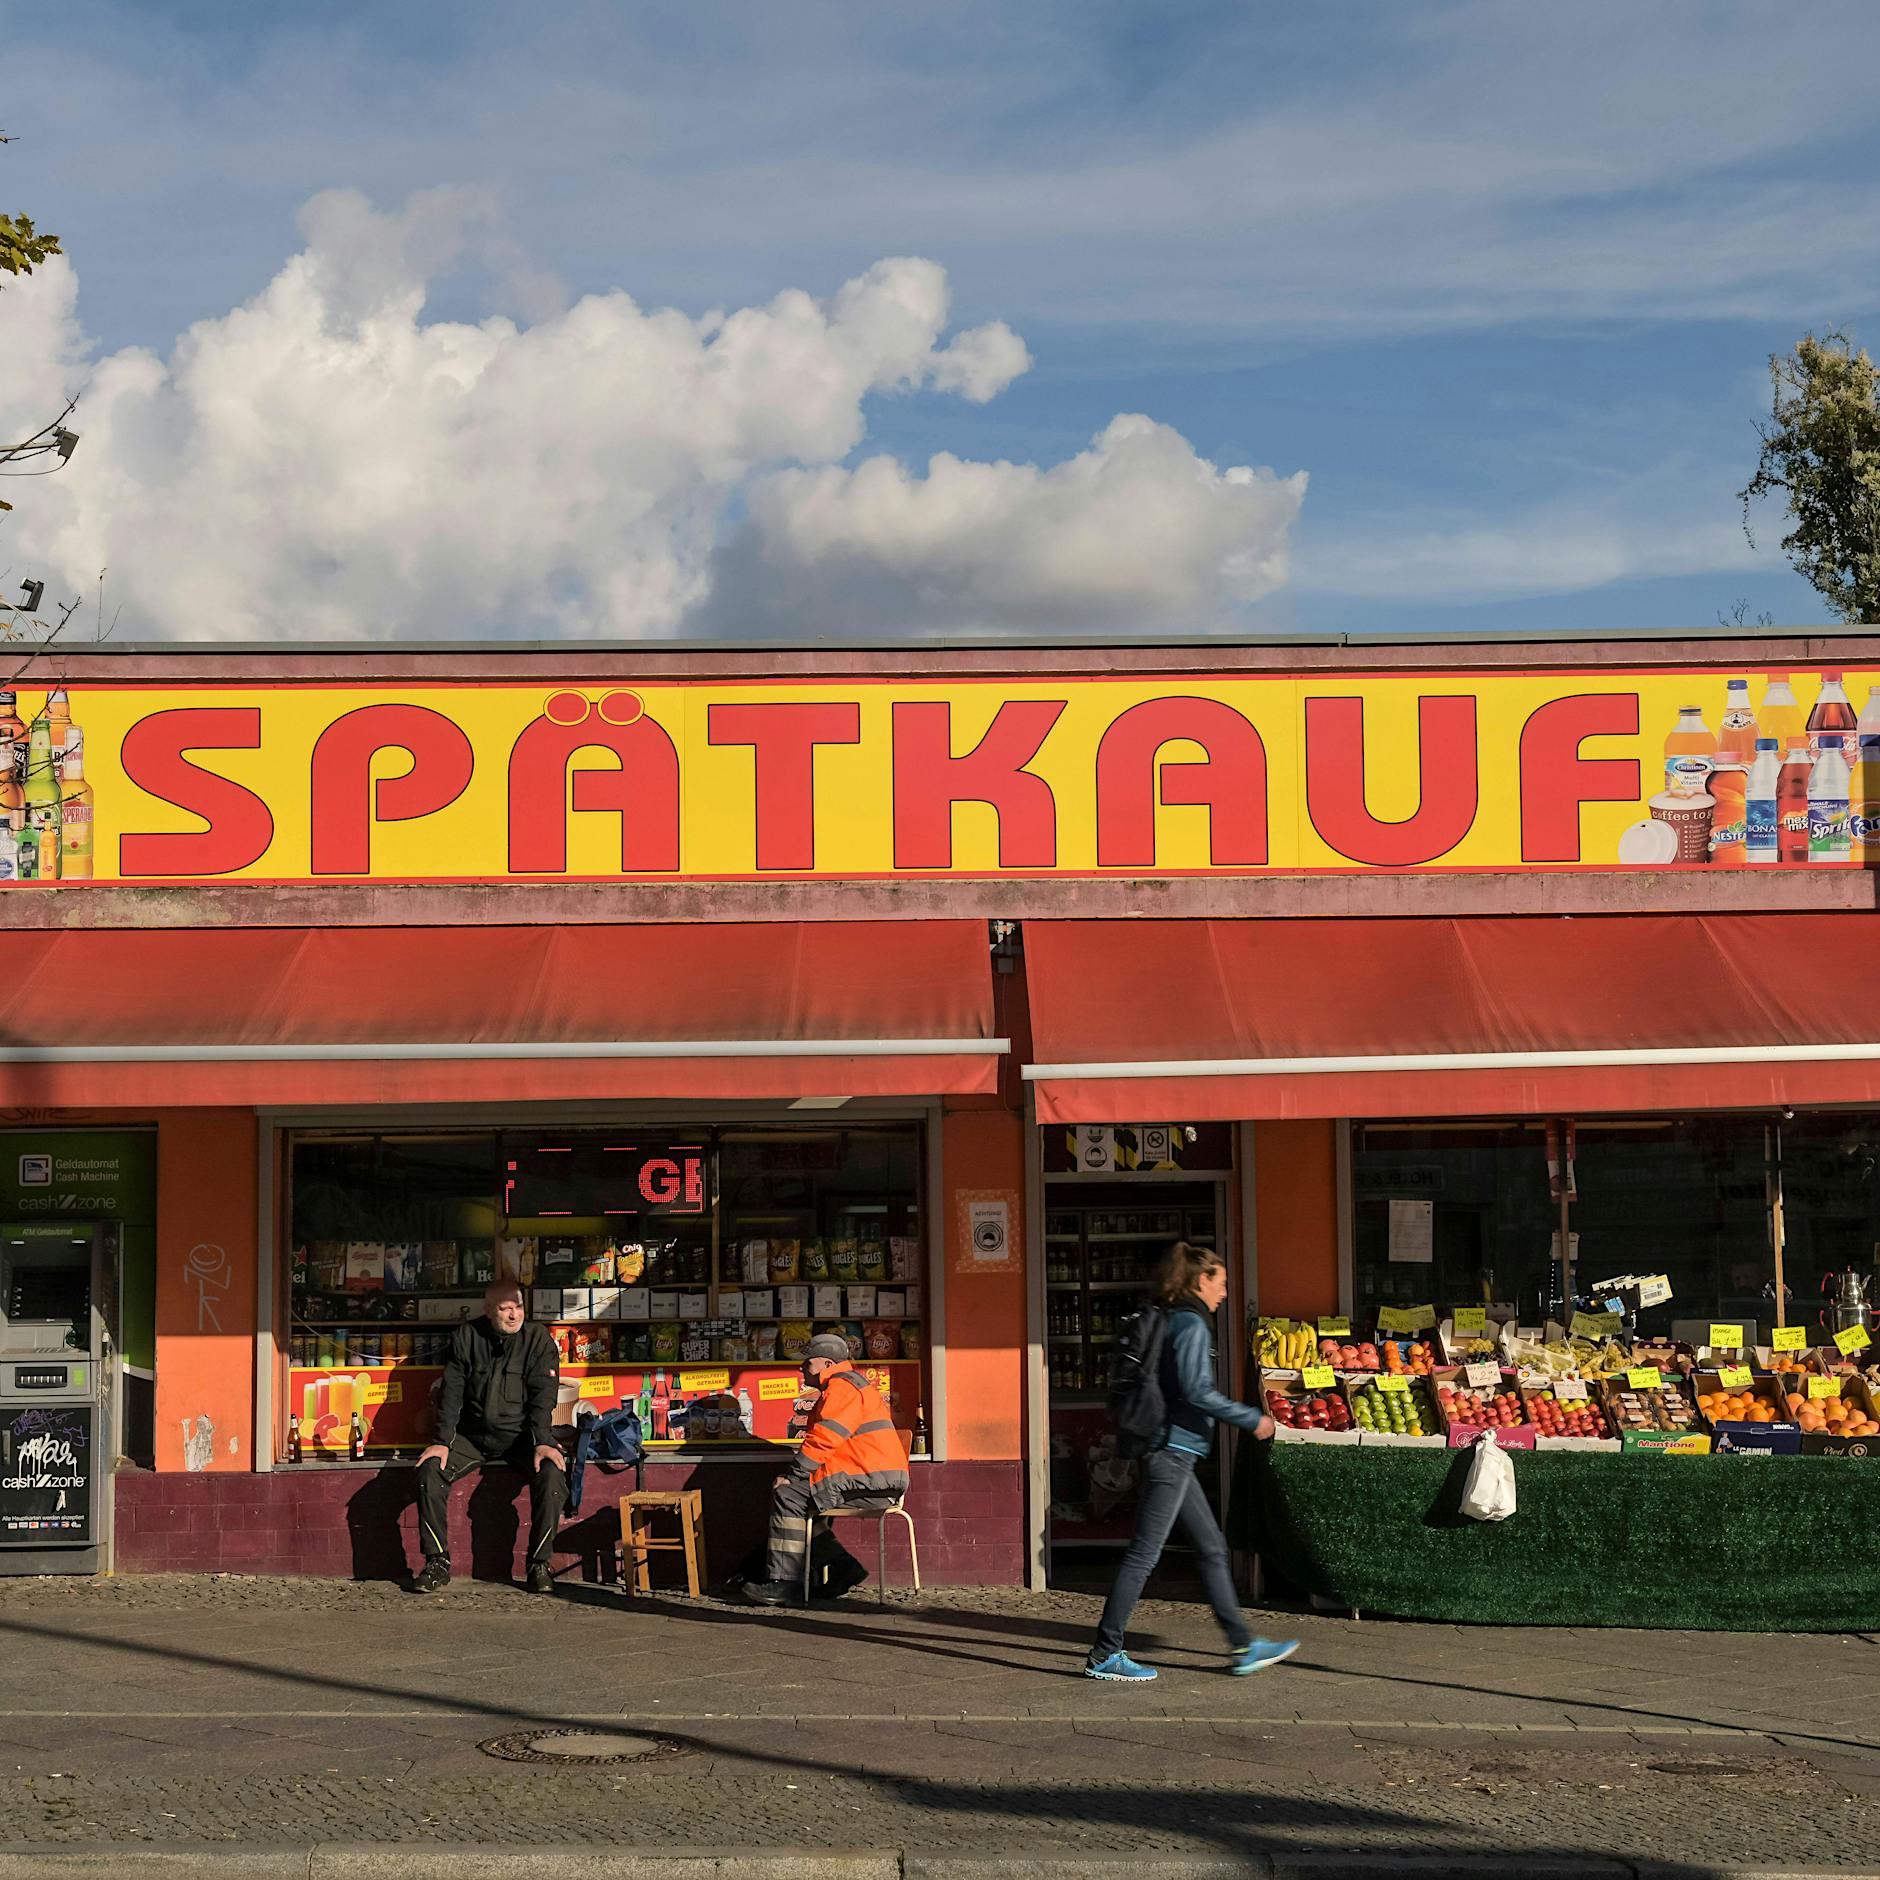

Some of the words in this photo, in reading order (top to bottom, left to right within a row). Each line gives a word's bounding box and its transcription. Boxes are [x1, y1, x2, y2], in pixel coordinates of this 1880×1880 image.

[120, 689, 1641, 876] SPÄTKAUF
[1784, 816, 1808, 826] mez
[55, 1159, 119, 1169] Geldautomat
[56, 1173, 78, 1181] Cash
[80, 1172, 119, 1181] Machine
[681, 1340, 710, 1351] SUPER
[685, 1373, 725, 1381] ALKOHOLFREIE
[1638, 1440, 1695, 1449] Mantione
